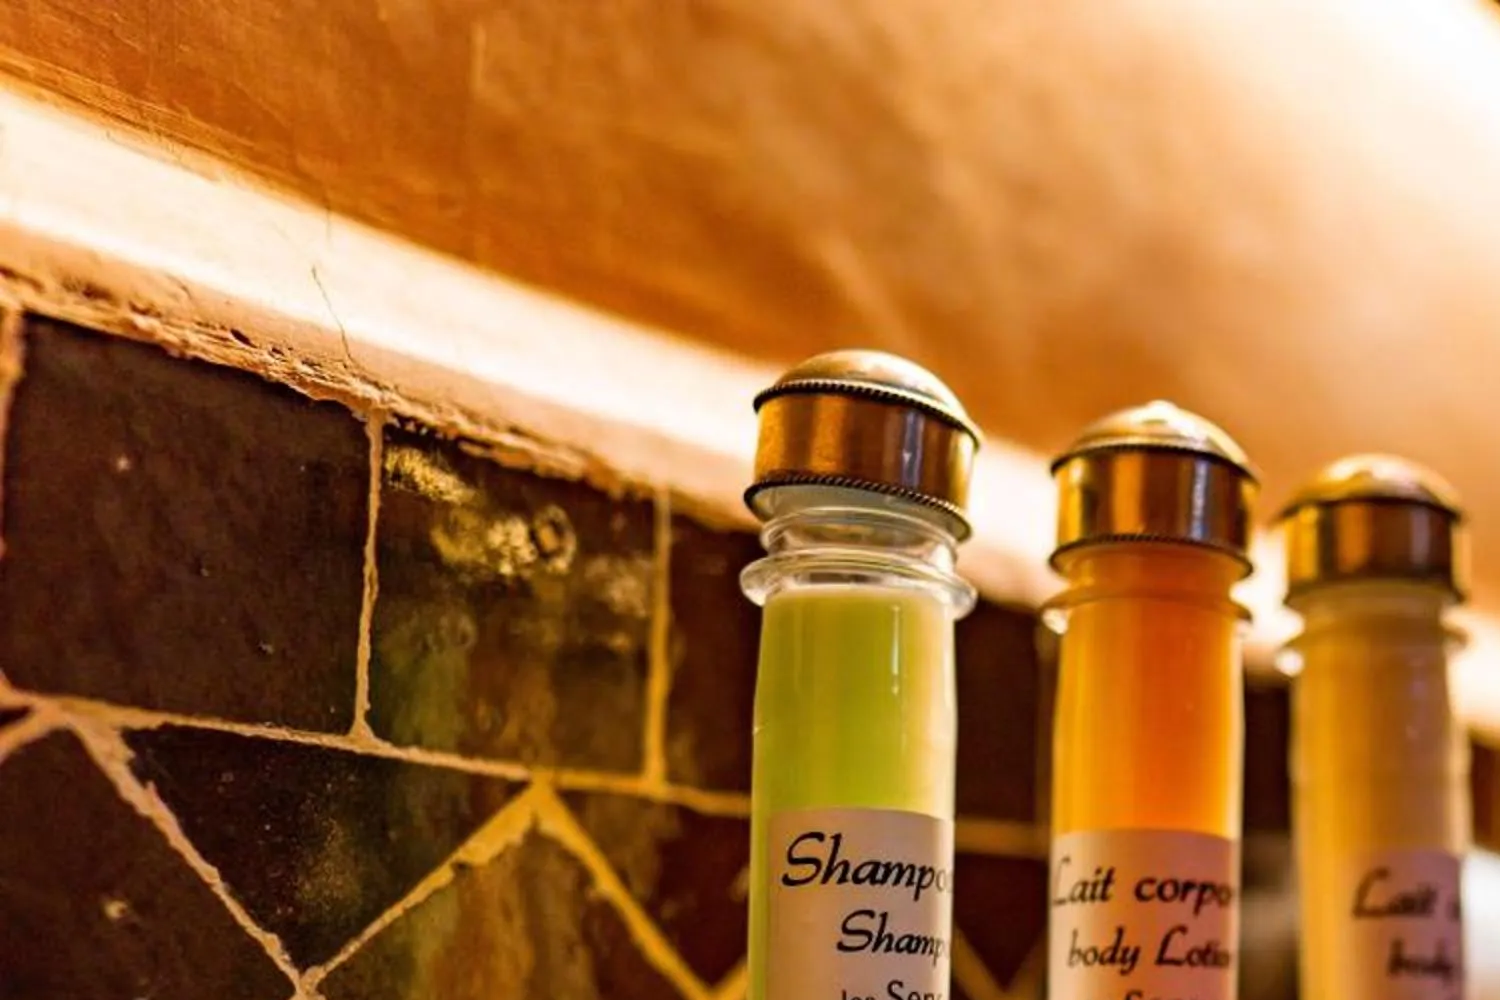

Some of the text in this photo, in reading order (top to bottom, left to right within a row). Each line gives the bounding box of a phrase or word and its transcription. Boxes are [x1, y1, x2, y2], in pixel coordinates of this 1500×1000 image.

[781, 831, 952, 902] Shampo
[1052, 855, 1116, 907] Lait
[1067, 926, 1141, 976] body
